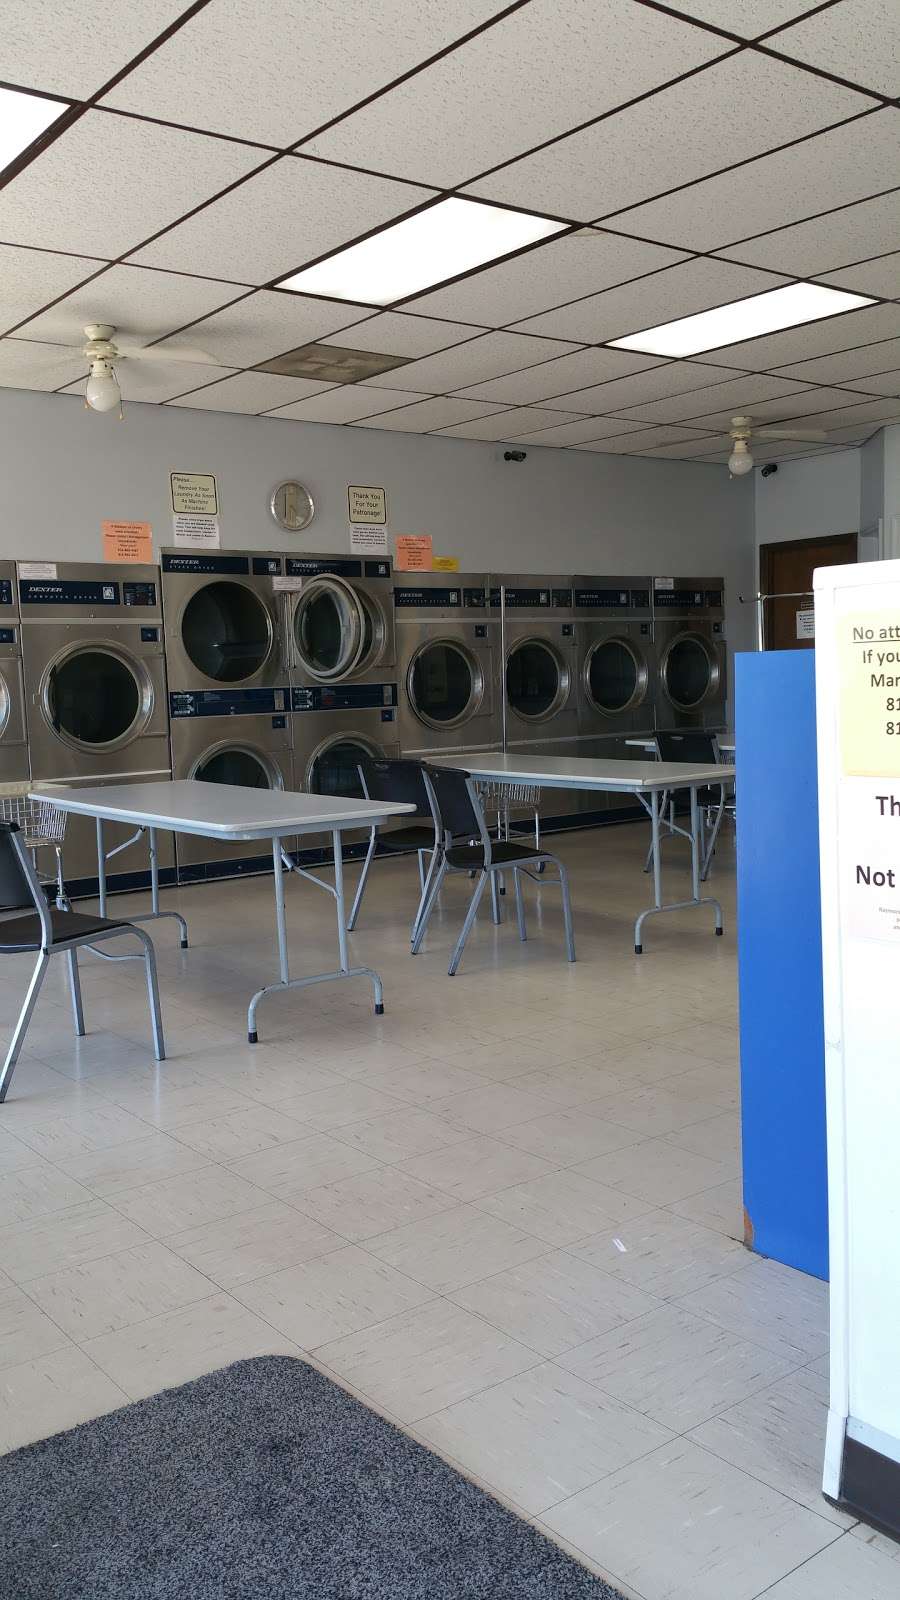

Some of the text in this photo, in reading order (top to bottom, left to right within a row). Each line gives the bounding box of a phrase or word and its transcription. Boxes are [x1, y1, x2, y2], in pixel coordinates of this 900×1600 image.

[852, 626, 875, 641] No
[862, 649, 873, 663] If
[855, 864, 896, 889] Not
